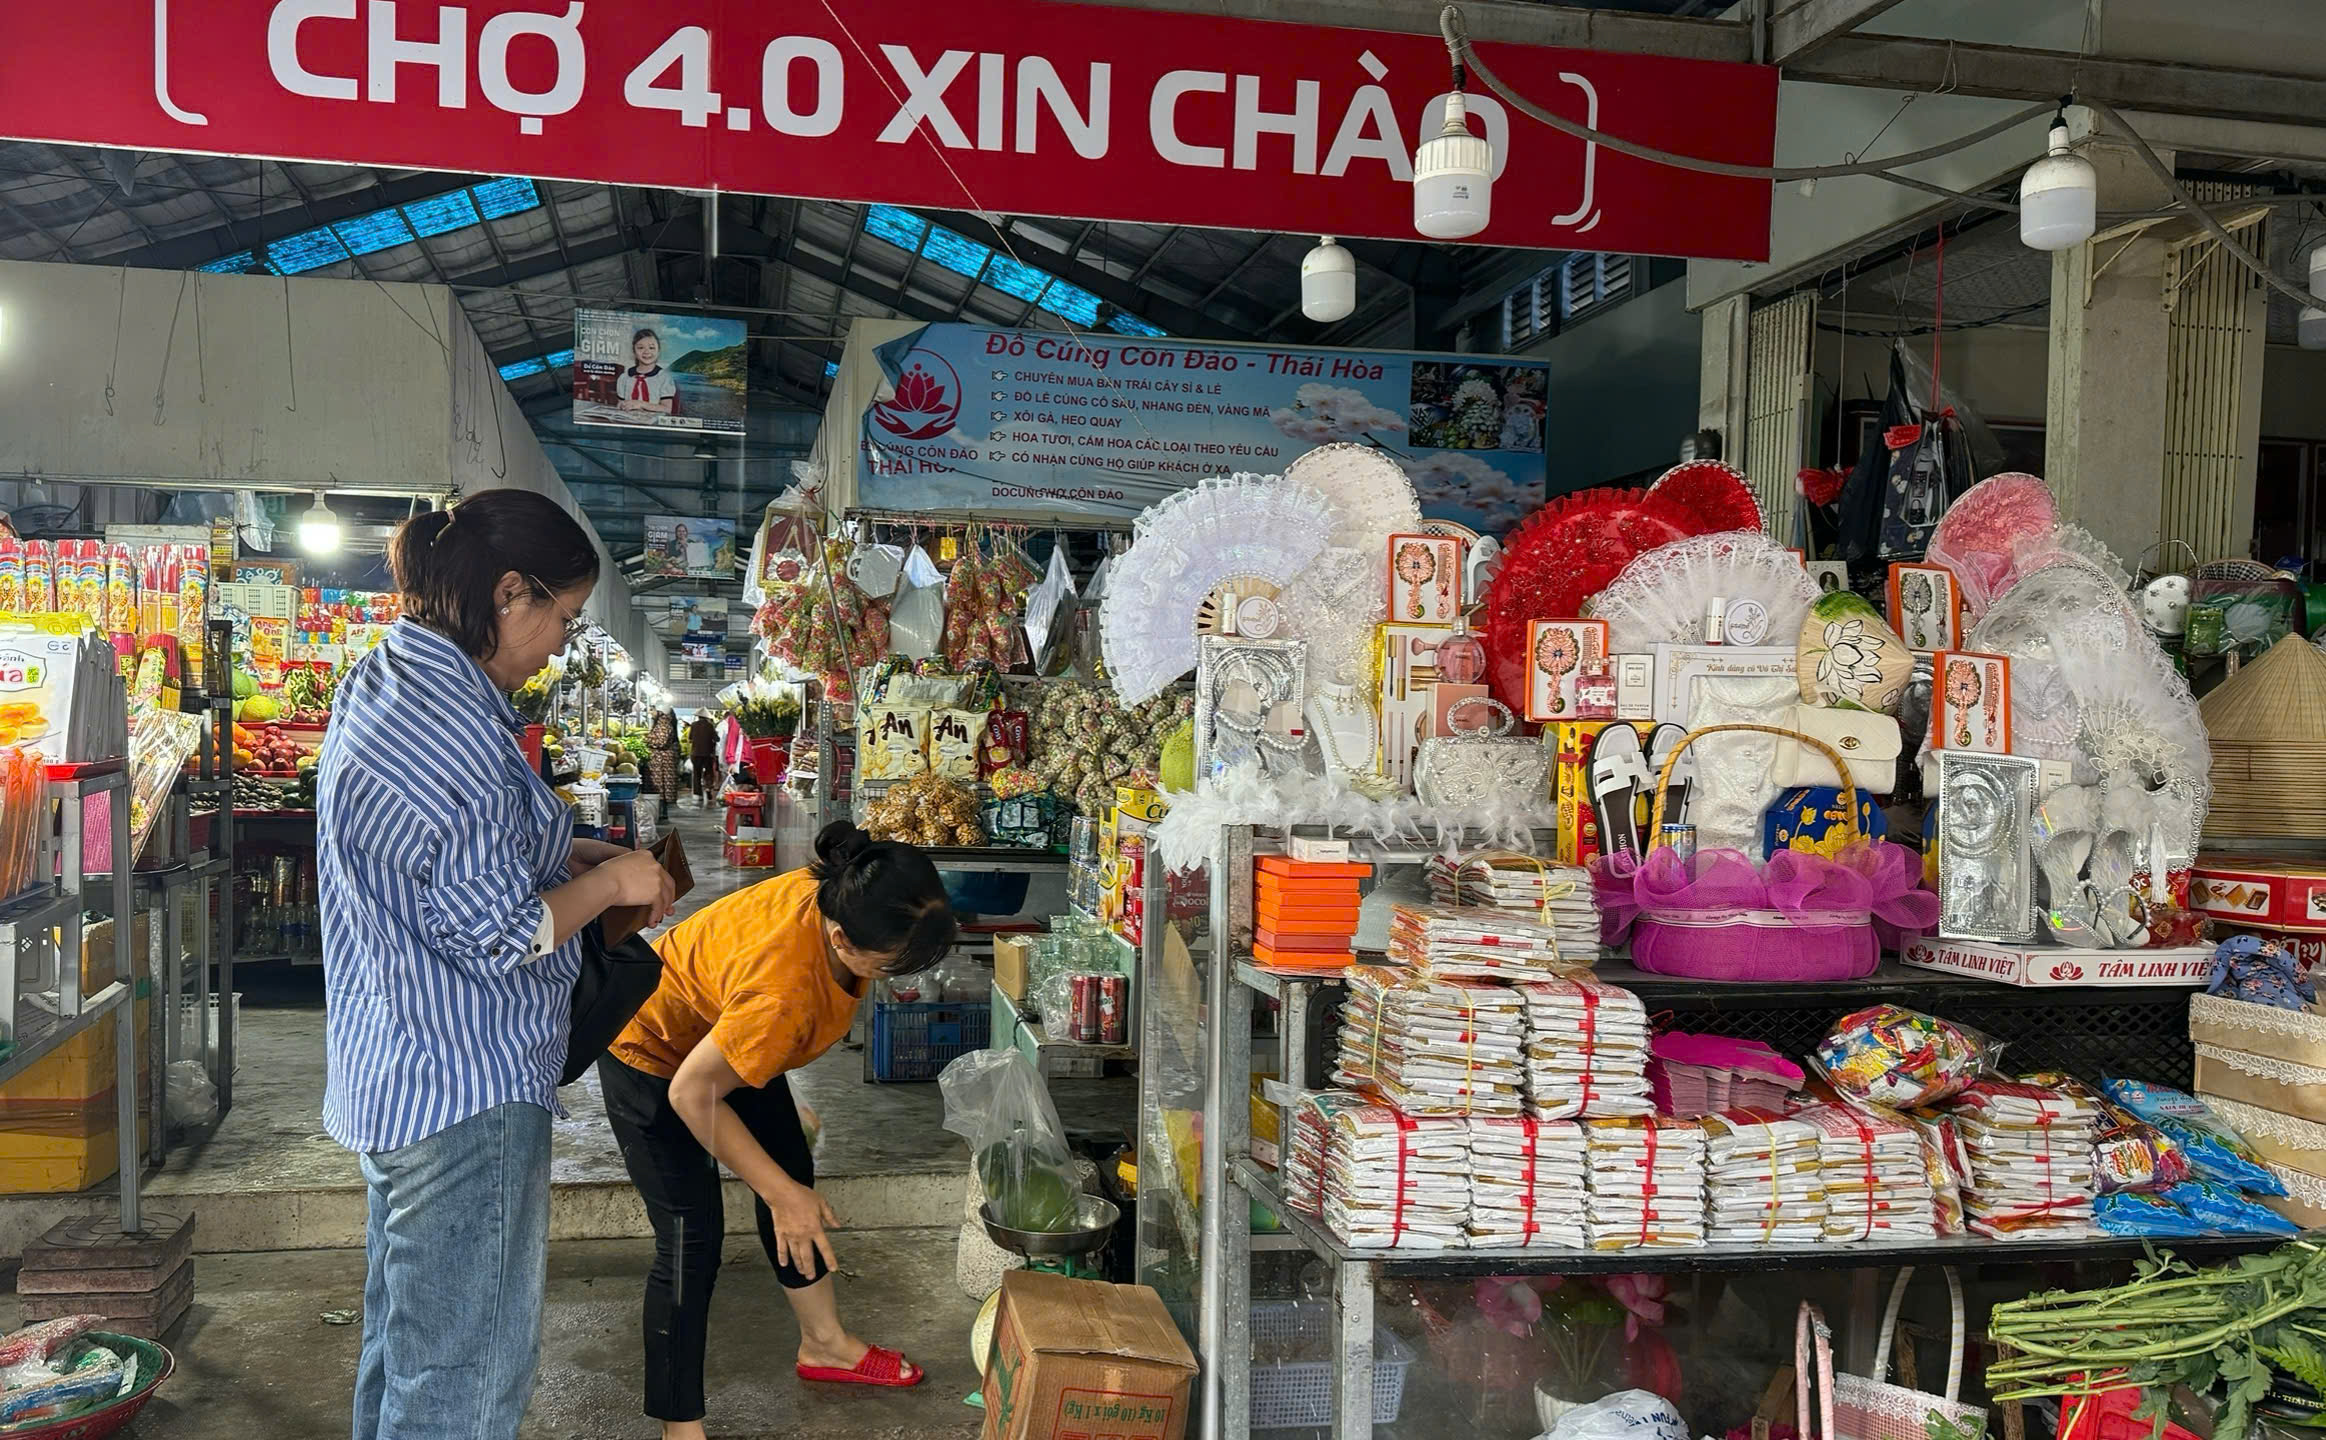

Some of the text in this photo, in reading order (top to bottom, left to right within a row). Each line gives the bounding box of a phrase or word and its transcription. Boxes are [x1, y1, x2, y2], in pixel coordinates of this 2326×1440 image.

[267, 0, 588, 135] CHỢ
[624, 26, 845, 138] 4.0
[876, 43, 1111, 160] XIN
[986, 332, 1026, 356] Đồ
[1035, 339, 1111, 370] Cúng
[1120, 346, 1176, 367] Côn
[1267, 354, 1325, 376] Thái
[1330, 358, 1384, 380] Hòa
[1014, 371, 1064, 384] CHUYÊN
[1067, 376, 1094, 388] MUA
[1097, 377, 1122, 389] BÁN
[1125, 378, 1152, 390] TRÁI
[1154, 379, 1179, 392] CÂY
[1195, 384, 1204, 394] &
[1053, 393, 1088, 407] CÚNG
[1142, 400, 1184, 413] NHANG
[1217, 403, 1250, 416] VÀNG
[1253, 406, 1271, 417] MÃ
[1014, 409, 1034, 422] XÔI
[1061, 414, 1087, 425] HEO
[1090, 416, 1122, 428] QUAY
[918, 445, 946, 458] CÔN
[950, 447, 979, 461] ĐẢO
[1012, 432, 1039, 443] HOA
[1107, 438, 1132, 449] HOA
[1163, 441, 1191, 454] LOẠI
[1194, 443, 1225, 455] THEO
[1228, 442, 1252, 455] YÊU
[1011, 450, 1030, 463] CÓ
[1069, 453, 1104, 467] CÚNG
[1127, 457, 1156, 470] GIÚP
[1158, 460, 1199, 473] KHÁCH
[1215, 464, 1231, 474] XA
[1617, 833, 1630, 867] FASHION
[1938, 947, 2016, 979] TÂM LINH VIỆT
[2098, 959, 2134, 978] TÂM
[2138, 961, 2180, 978] LINH
